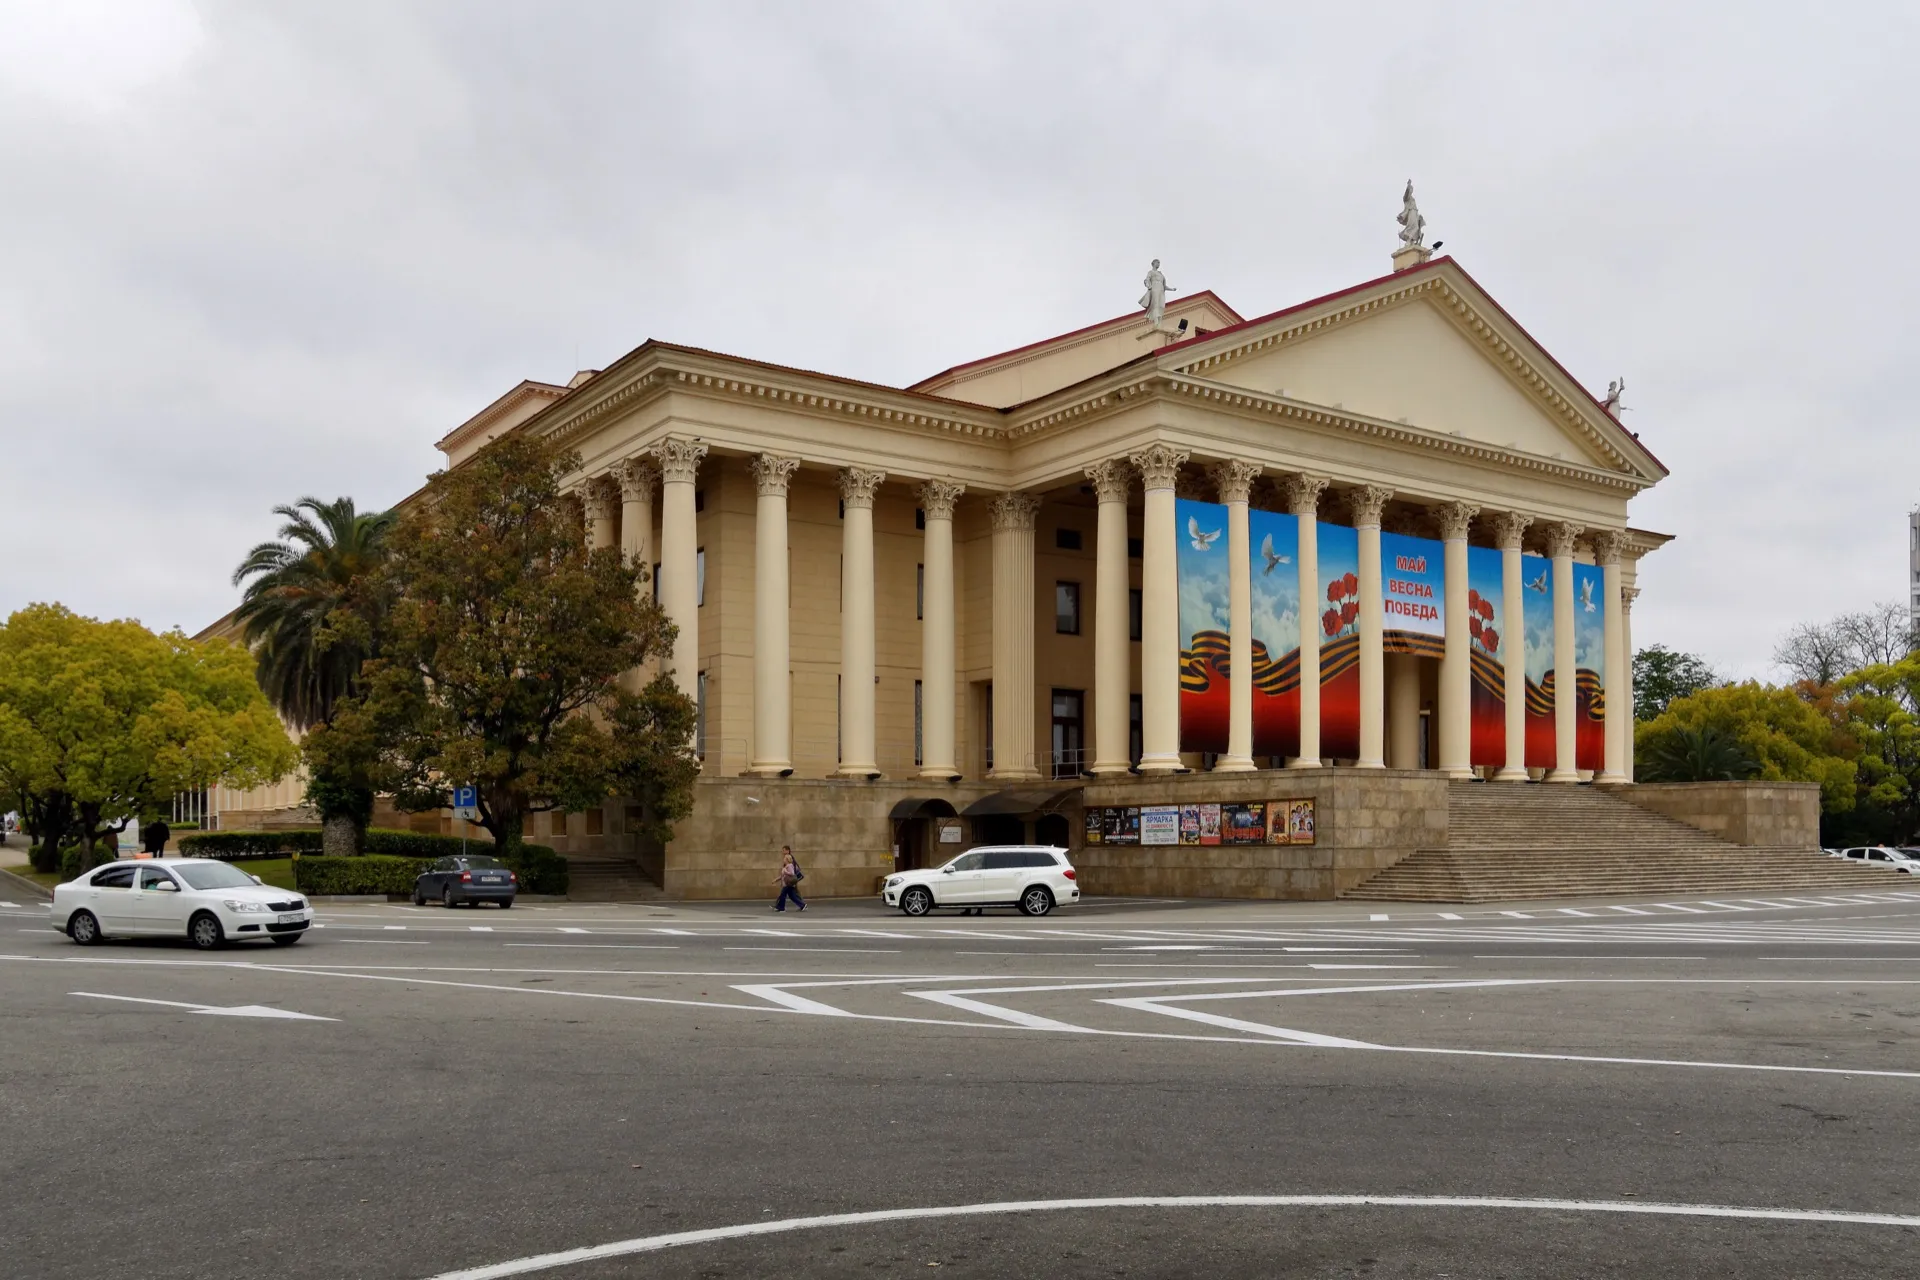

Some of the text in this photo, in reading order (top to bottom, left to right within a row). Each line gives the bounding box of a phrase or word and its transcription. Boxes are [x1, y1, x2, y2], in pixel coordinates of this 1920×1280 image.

[1396, 555, 1427, 573] МАЙ
[1389, 579, 1433, 598] ВЕСНА
[1384, 599, 1439, 621] ПОБЕДА
[460, 787, 473, 805] P
[1146, 815, 1173, 823] ЯРМАРКА
